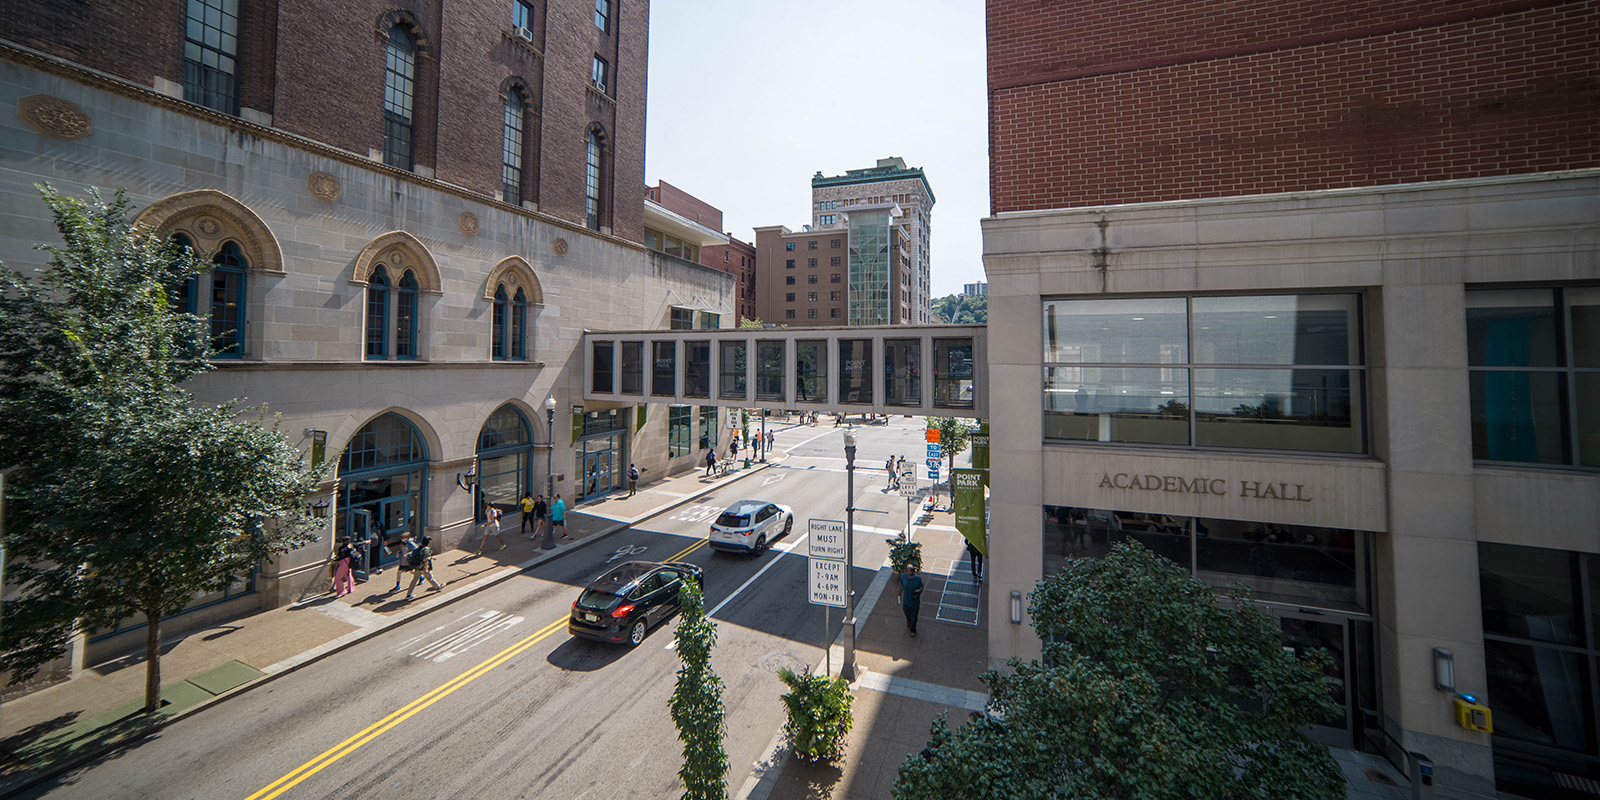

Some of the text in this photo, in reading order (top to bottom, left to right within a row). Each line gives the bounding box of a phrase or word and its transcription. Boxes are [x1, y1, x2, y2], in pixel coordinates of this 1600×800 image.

[927, 460, 941, 469] 376
[956, 473, 981, 481] POINT
[1098, 472, 1312, 502] ACADEMIC HALL
[811, 523, 827, 531] RIGHT
[817, 534, 837, 543] MUST
[811, 545, 844, 554] TURN RIGHT
[815, 561, 840, 571] EXCEPT
[813, 592, 843, 602] MON-FRI
